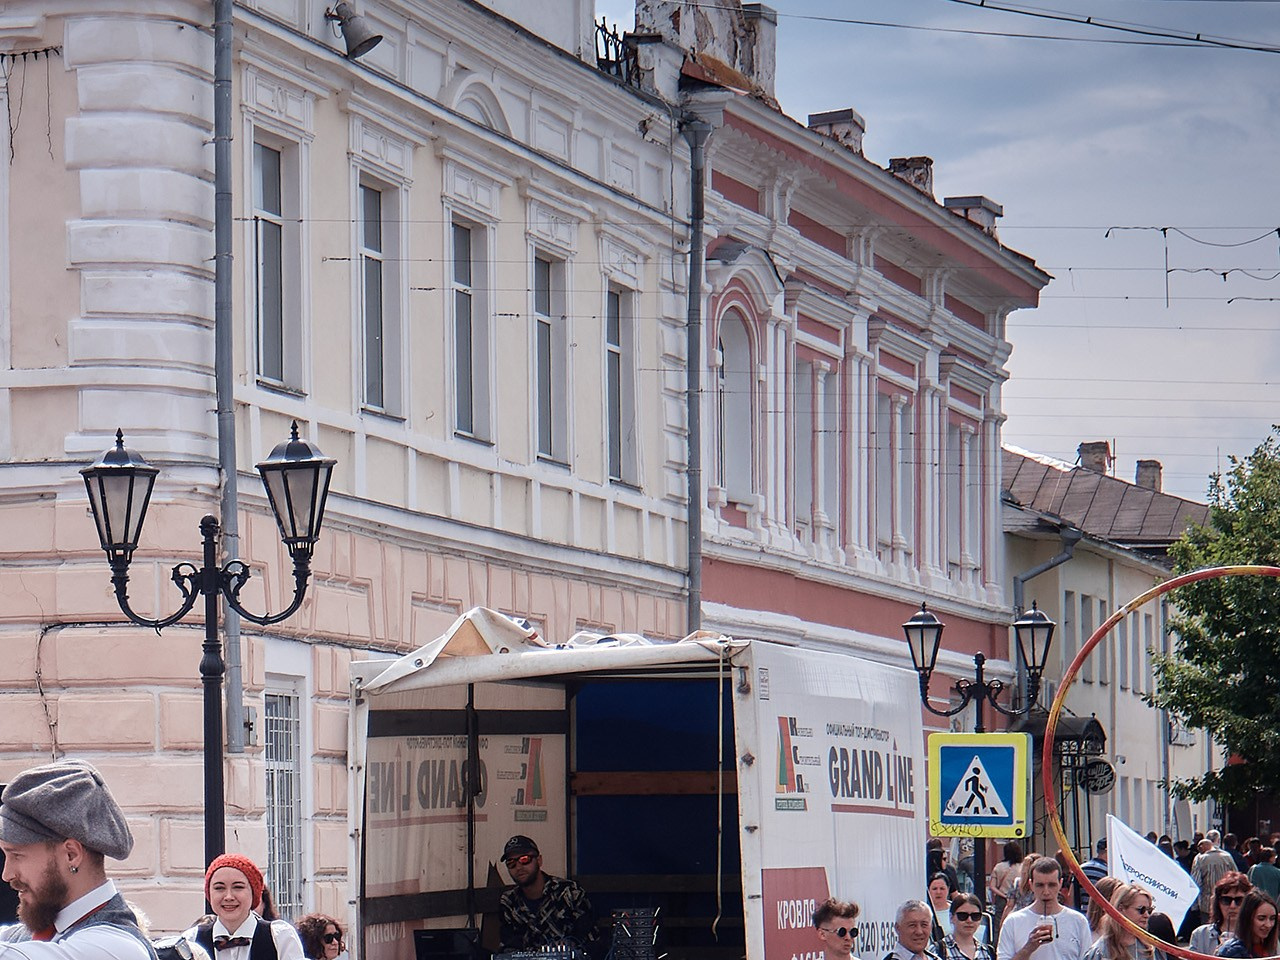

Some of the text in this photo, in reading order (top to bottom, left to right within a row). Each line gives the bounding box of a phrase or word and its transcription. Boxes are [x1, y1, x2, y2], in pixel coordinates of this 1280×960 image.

[829, 746, 914, 805] GRAND LINE
[777, 898, 815, 930] КРОВЛЯ
